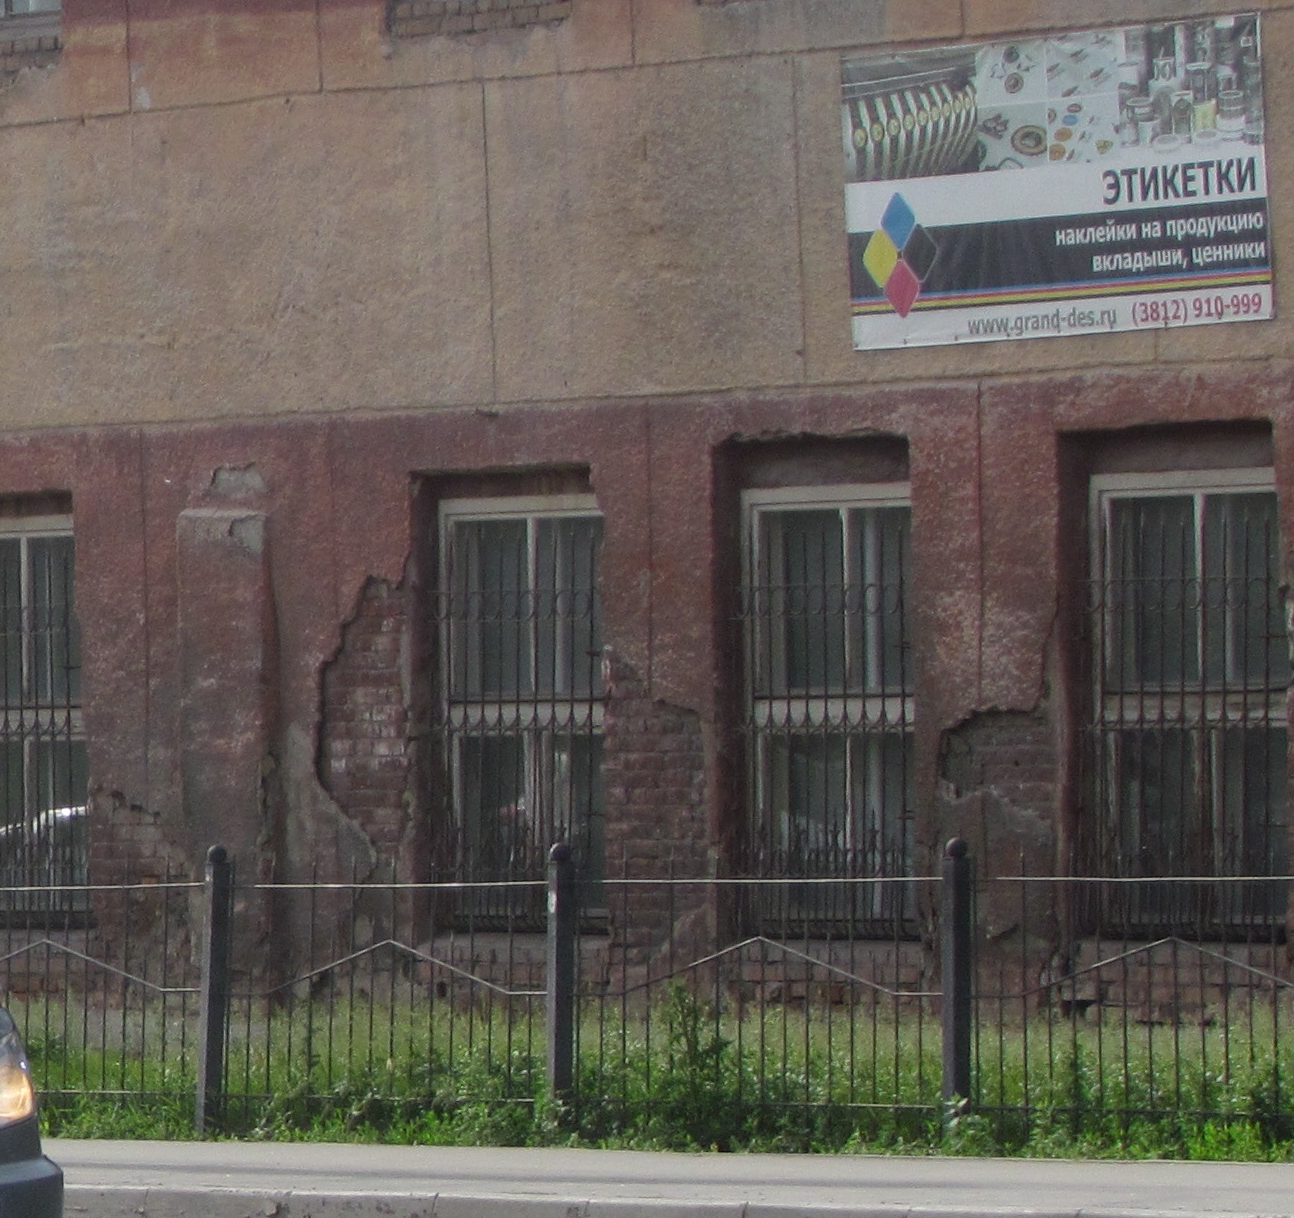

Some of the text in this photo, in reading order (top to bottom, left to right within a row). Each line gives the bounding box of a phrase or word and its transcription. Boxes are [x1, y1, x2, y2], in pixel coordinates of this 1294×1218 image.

[1102, 157, 1256, 205] ЭТИКЕТКИ
[1055, 211, 1263, 247] наклейки на продукцию
[1092, 241, 1265, 272] вкладыши, ценники
[968, 308, 1117, 337] www.grand-des.ru
[1131, 293, 1262, 326] (3812) 910-999
